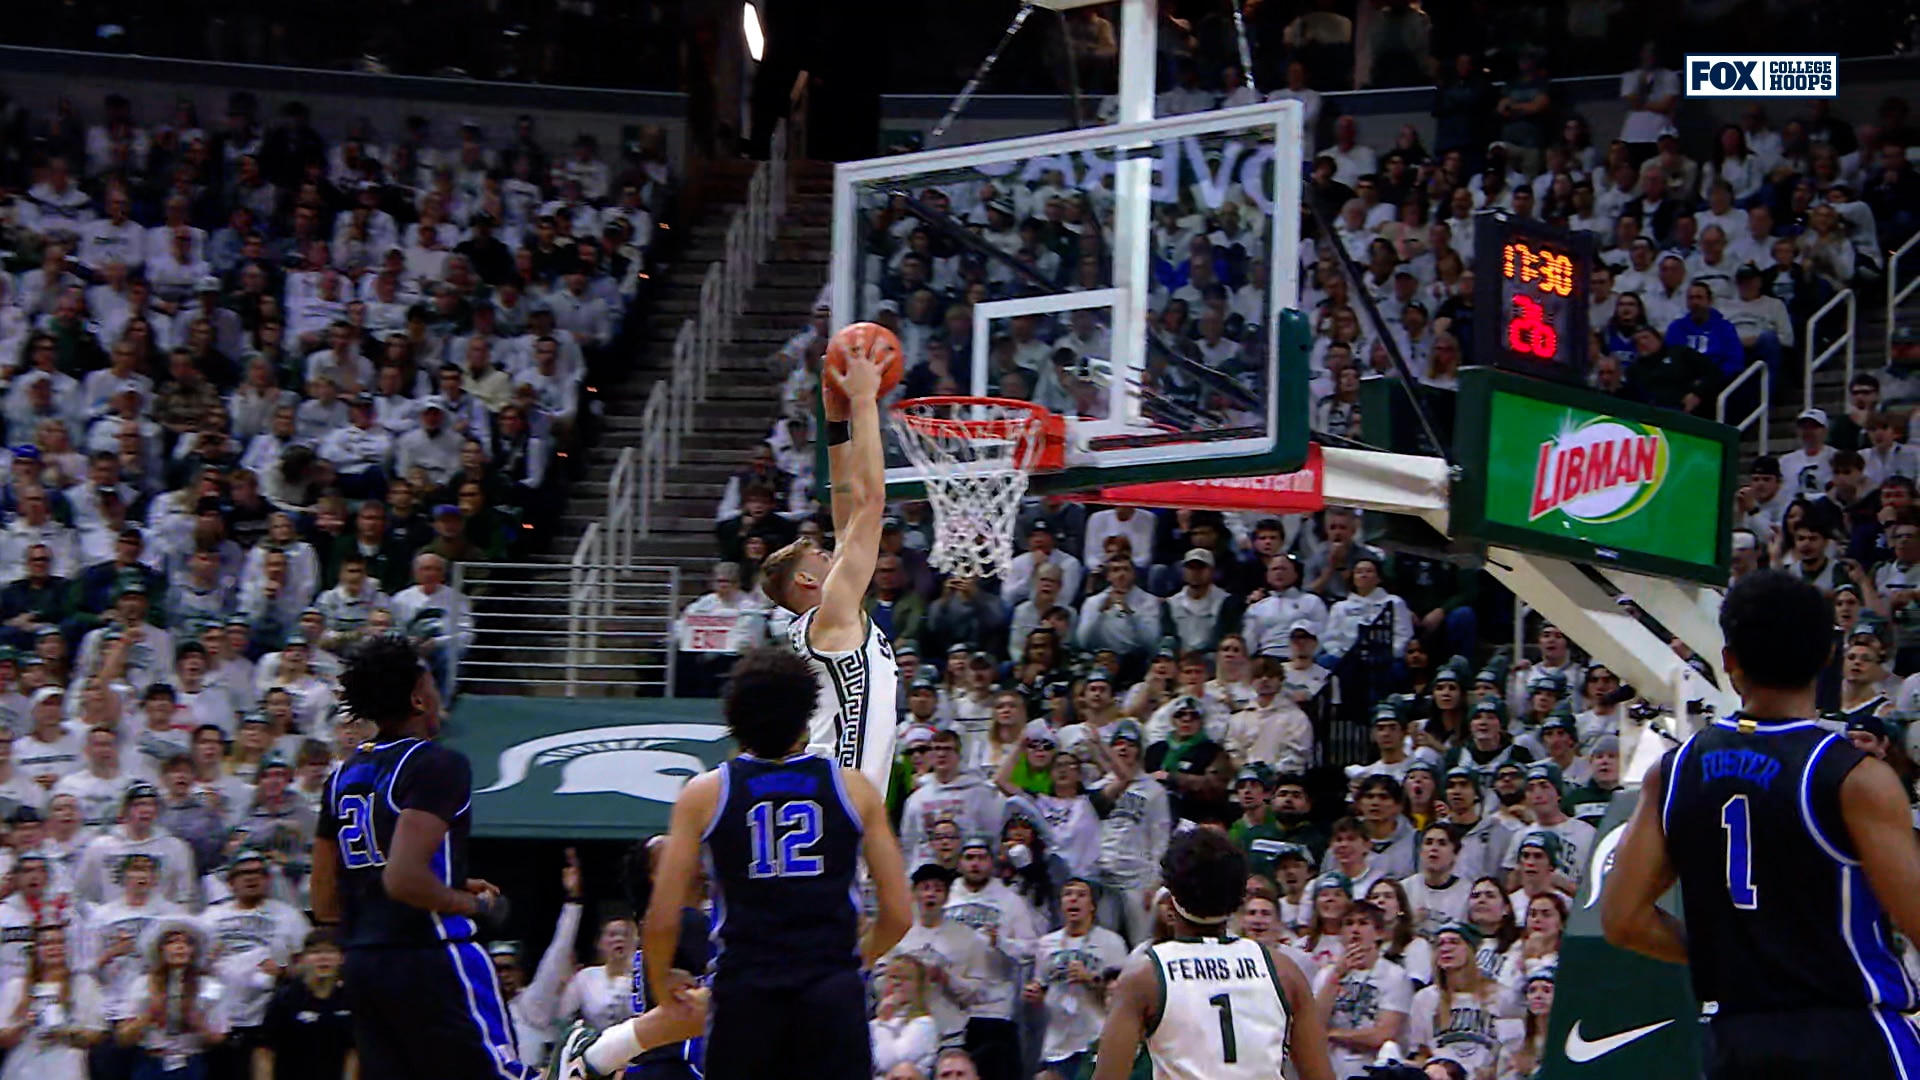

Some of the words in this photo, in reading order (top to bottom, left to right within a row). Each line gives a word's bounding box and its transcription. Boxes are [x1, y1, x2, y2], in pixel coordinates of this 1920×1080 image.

[1529, 434, 1659, 520] LIBMAN
[1701, 749, 1783, 792] FOSTER
[338, 791, 388, 870] 21
[746, 800, 825, 880] 12
[1721, 793, 1758, 910] 1
[1167, 958, 1231, 981] FEARS
[1236, 957, 1266, 979] JR.
[1209, 993, 1237, 1063] 1
